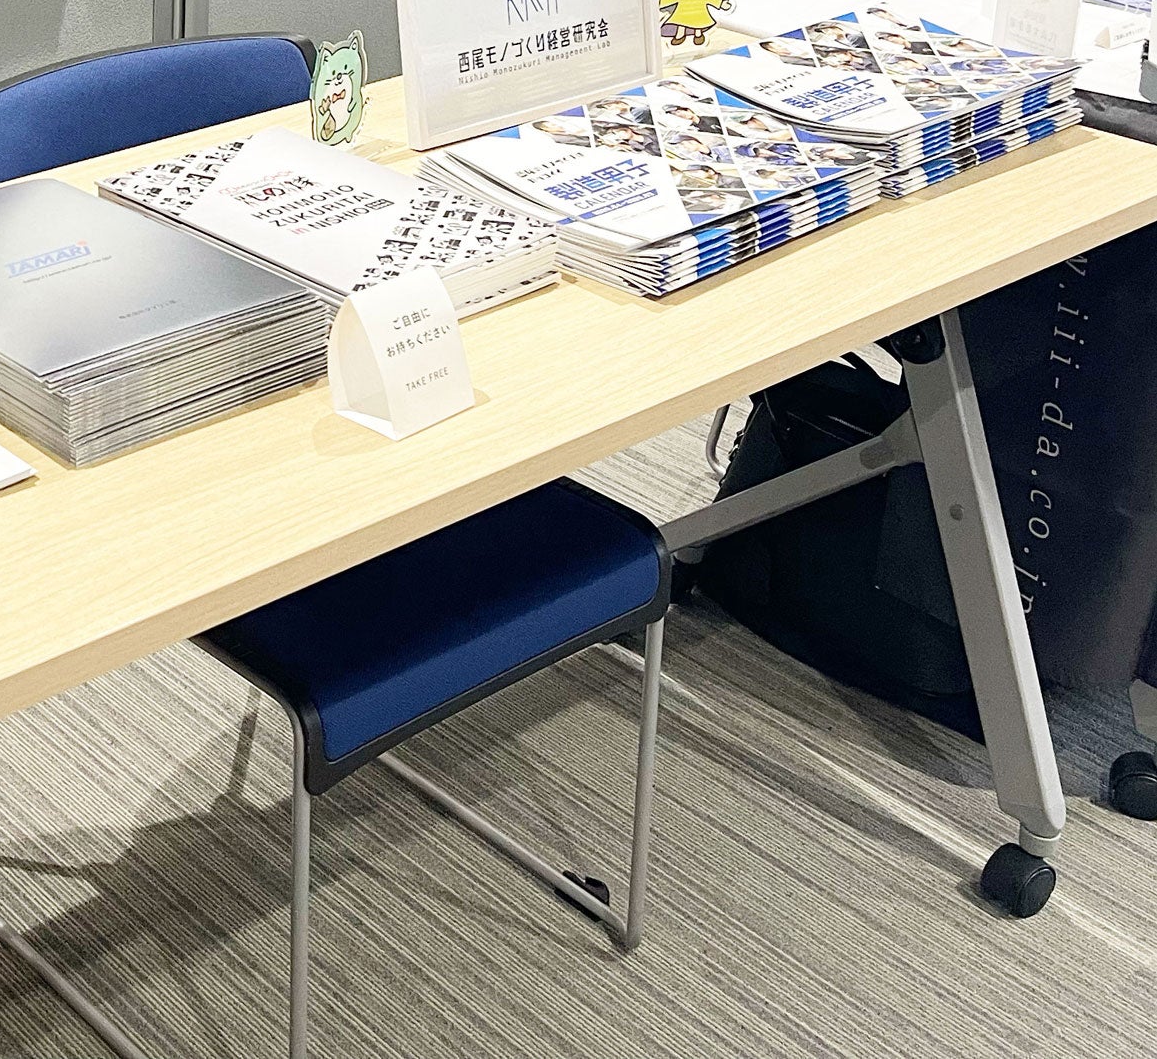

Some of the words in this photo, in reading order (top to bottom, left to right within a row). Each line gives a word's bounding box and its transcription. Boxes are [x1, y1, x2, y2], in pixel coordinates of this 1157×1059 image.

[458, 17, 609, 73] 西尾モノづくり経営研究会
[544, 158, 651, 201] 製造男子
[574, 181, 650, 210] CALENDAR
[251, 185, 354, 219] HONMONO
[269, 192, 375, 227] ZUKURITAI
[308, 206, 370, 230] NISHIO
[392, 308, 431, 330] ご自由に
[386, 325, 451, 358] お持ちください
[406, 376, 426, 391] TAKE
[429, 367, 448, 382] FREE
